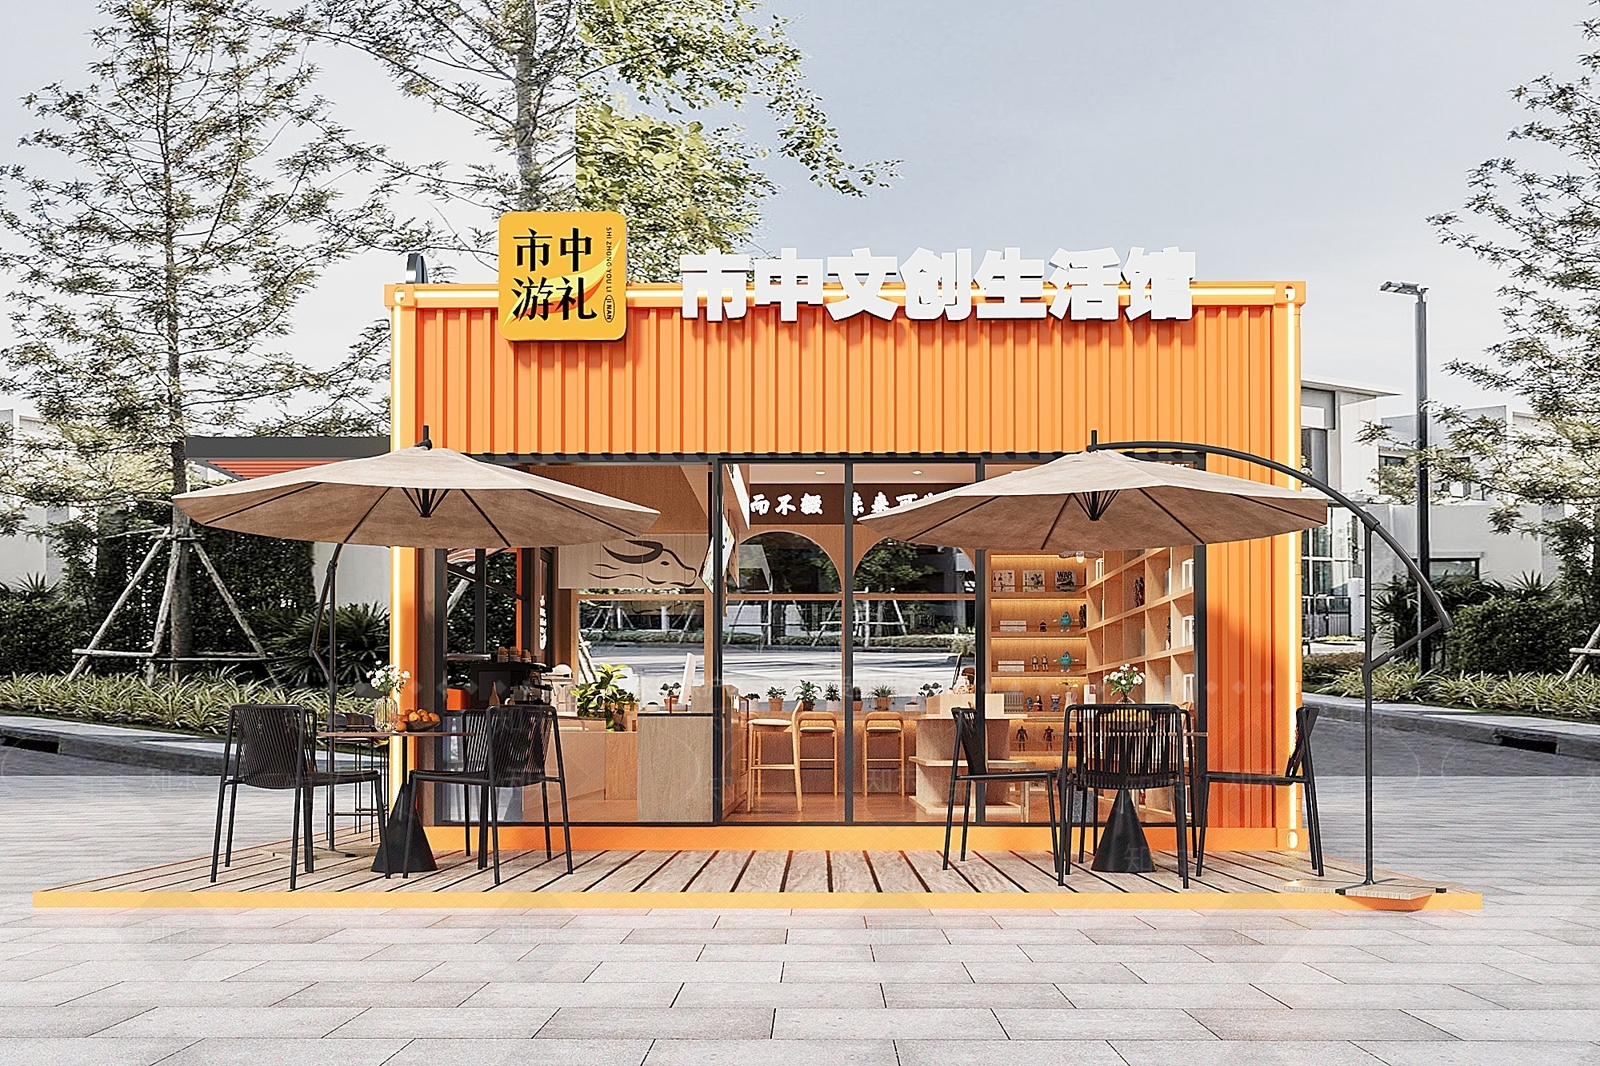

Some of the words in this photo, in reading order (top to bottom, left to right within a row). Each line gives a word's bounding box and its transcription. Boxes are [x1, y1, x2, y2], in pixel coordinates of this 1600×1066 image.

[605, 227, 613, 239] SHI
[512, 227, 593, 272] 市中
[605, 241, 613, 267] ZHONG
[605, 269, 613, 284] YOU
[680, 246, 1196, 322] 市中文创生活馆
[510, 276, 598, 321] 游礼
[605, 304, 613, 320] NAN
